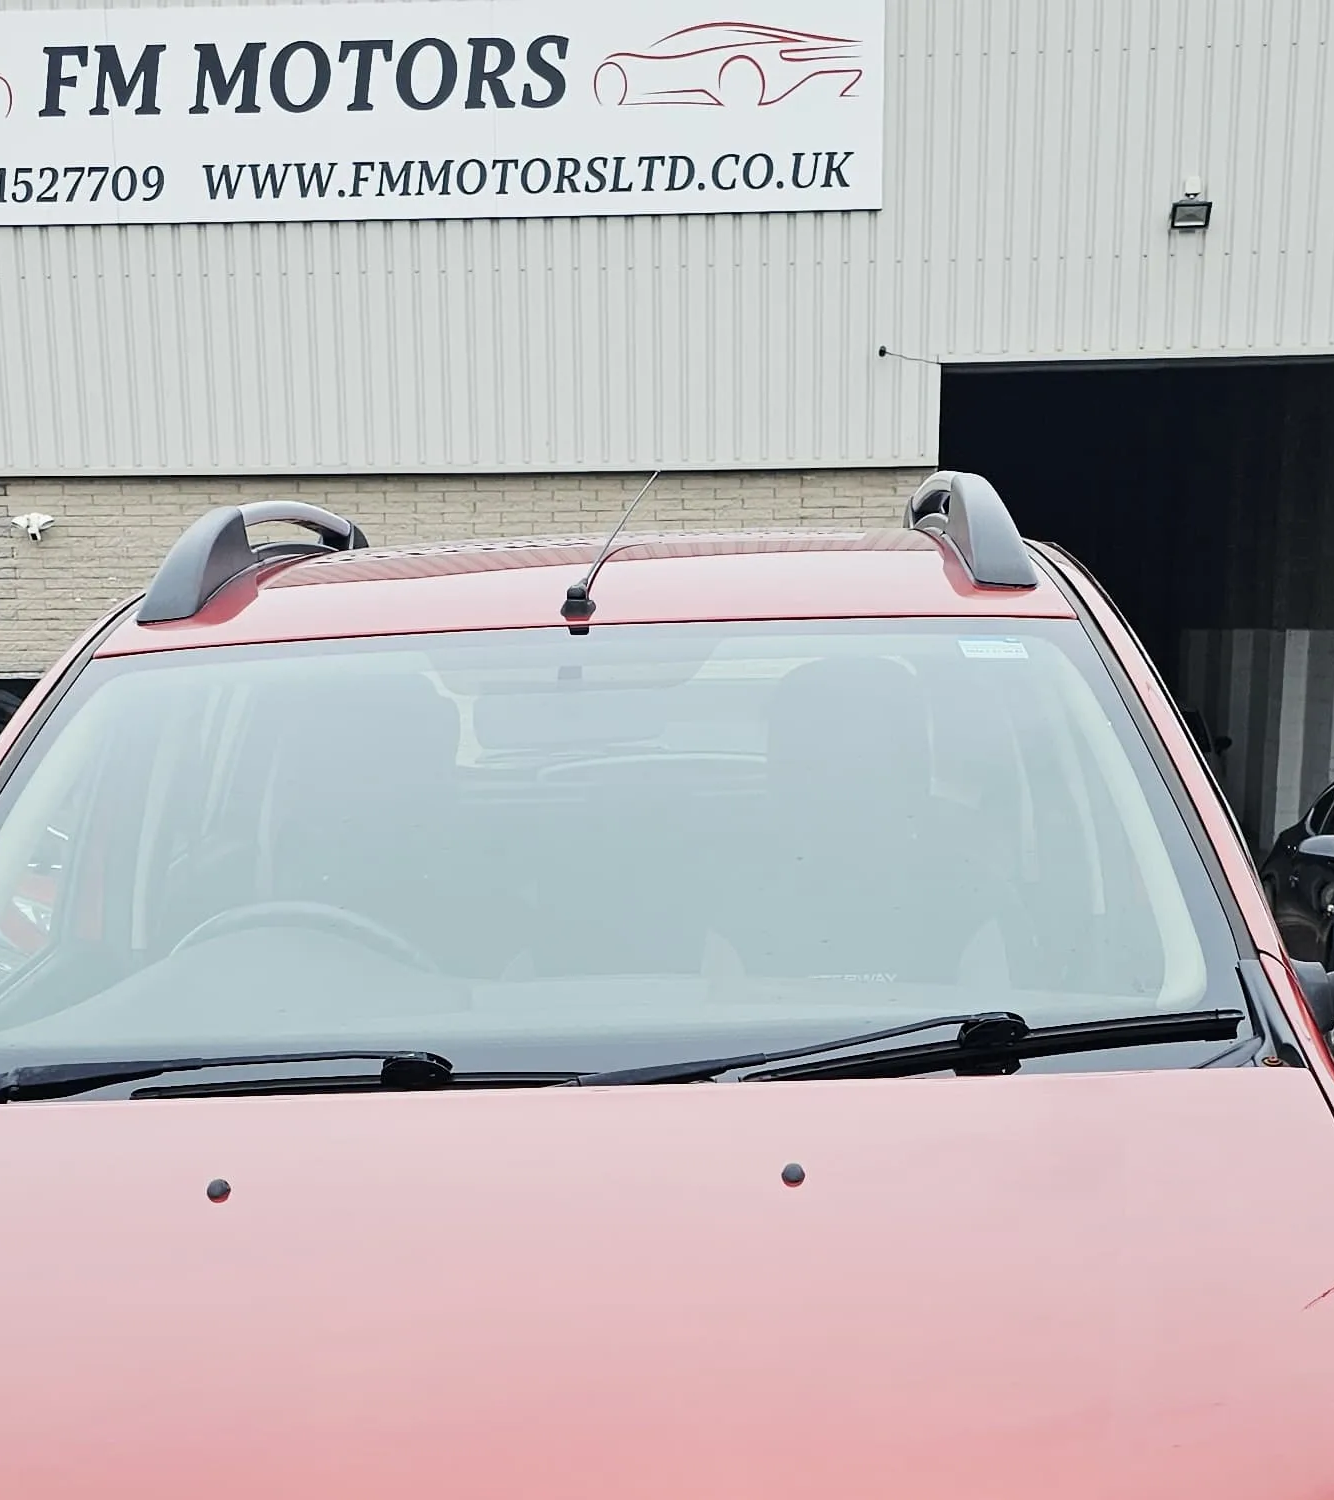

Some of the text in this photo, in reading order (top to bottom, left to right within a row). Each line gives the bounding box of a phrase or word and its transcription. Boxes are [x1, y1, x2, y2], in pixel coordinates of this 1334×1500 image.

[38, 34, 570, 118] FM MOTORS
[202, 151, 856, 205] WWW.FMMOTORSLTD.CO.UK
